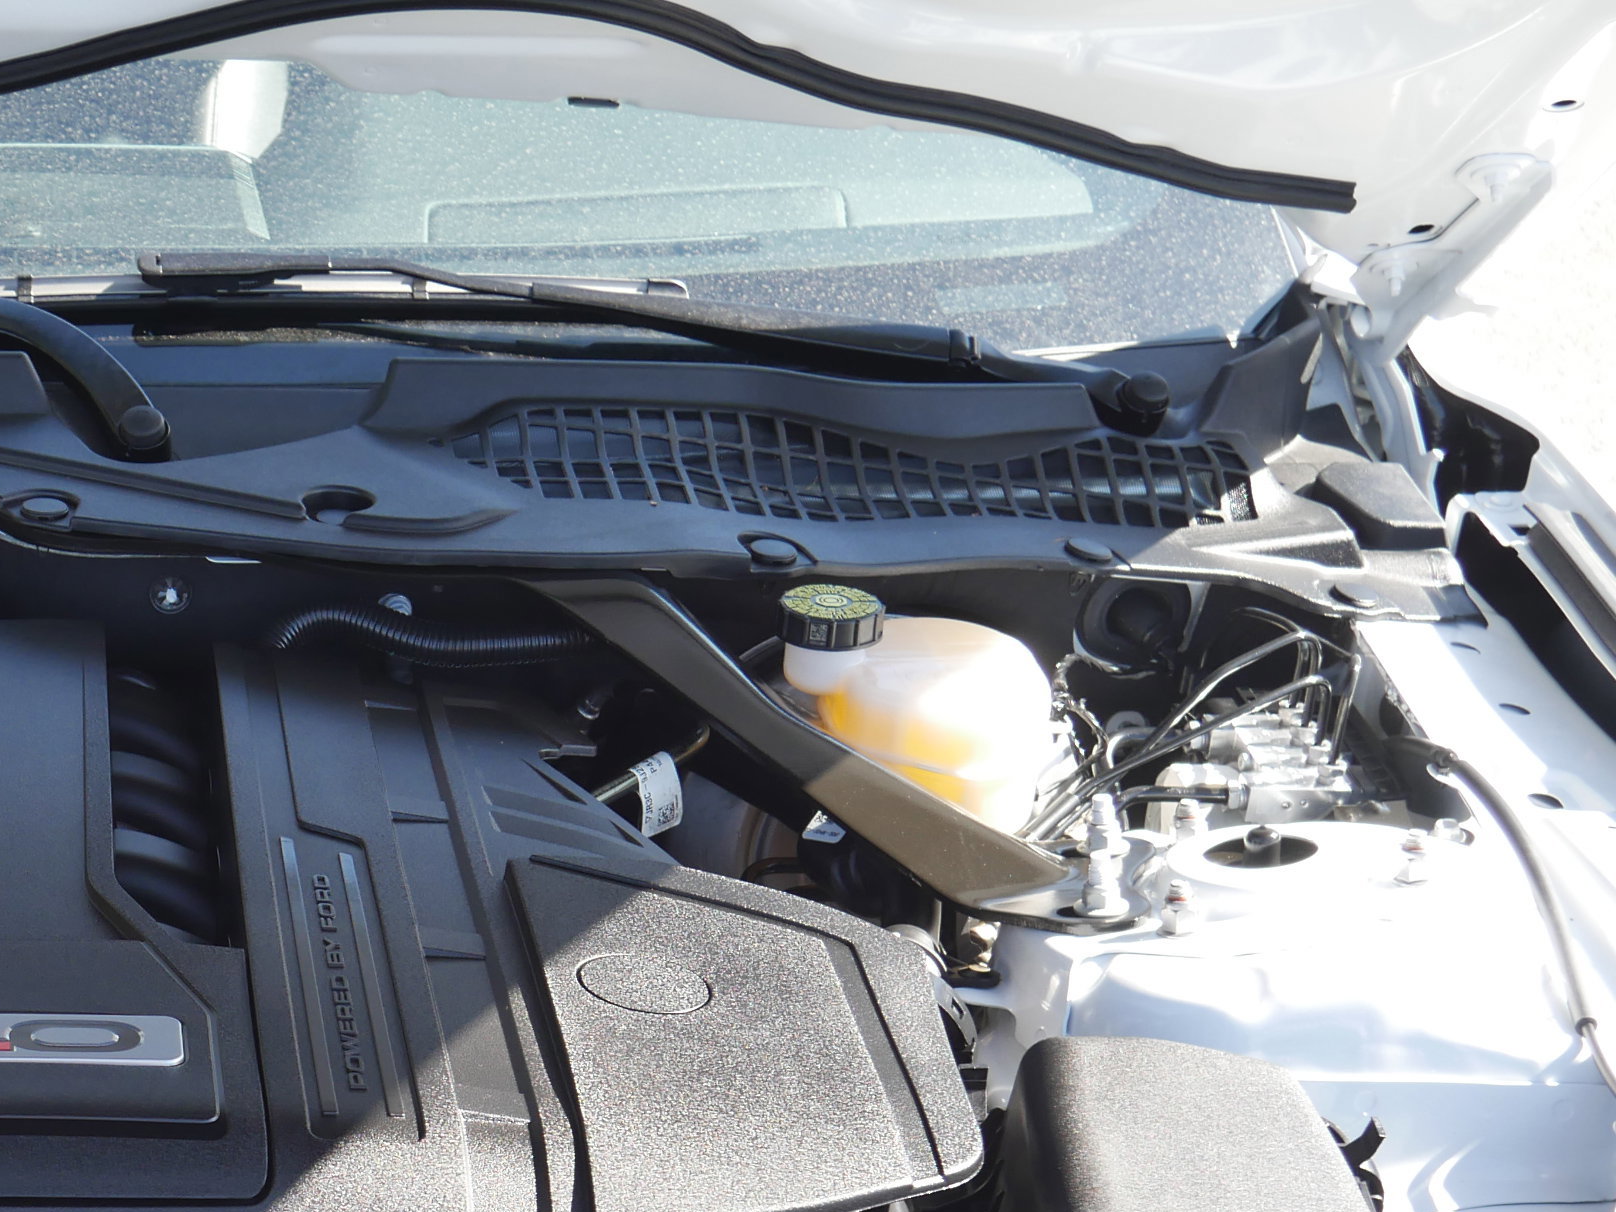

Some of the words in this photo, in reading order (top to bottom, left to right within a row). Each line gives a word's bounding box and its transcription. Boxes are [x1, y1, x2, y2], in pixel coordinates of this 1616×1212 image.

[312, 873, 337, 932] FORD
[322, 936, 345, 969] BY
[330, 975, 368, 1092] POWERED
